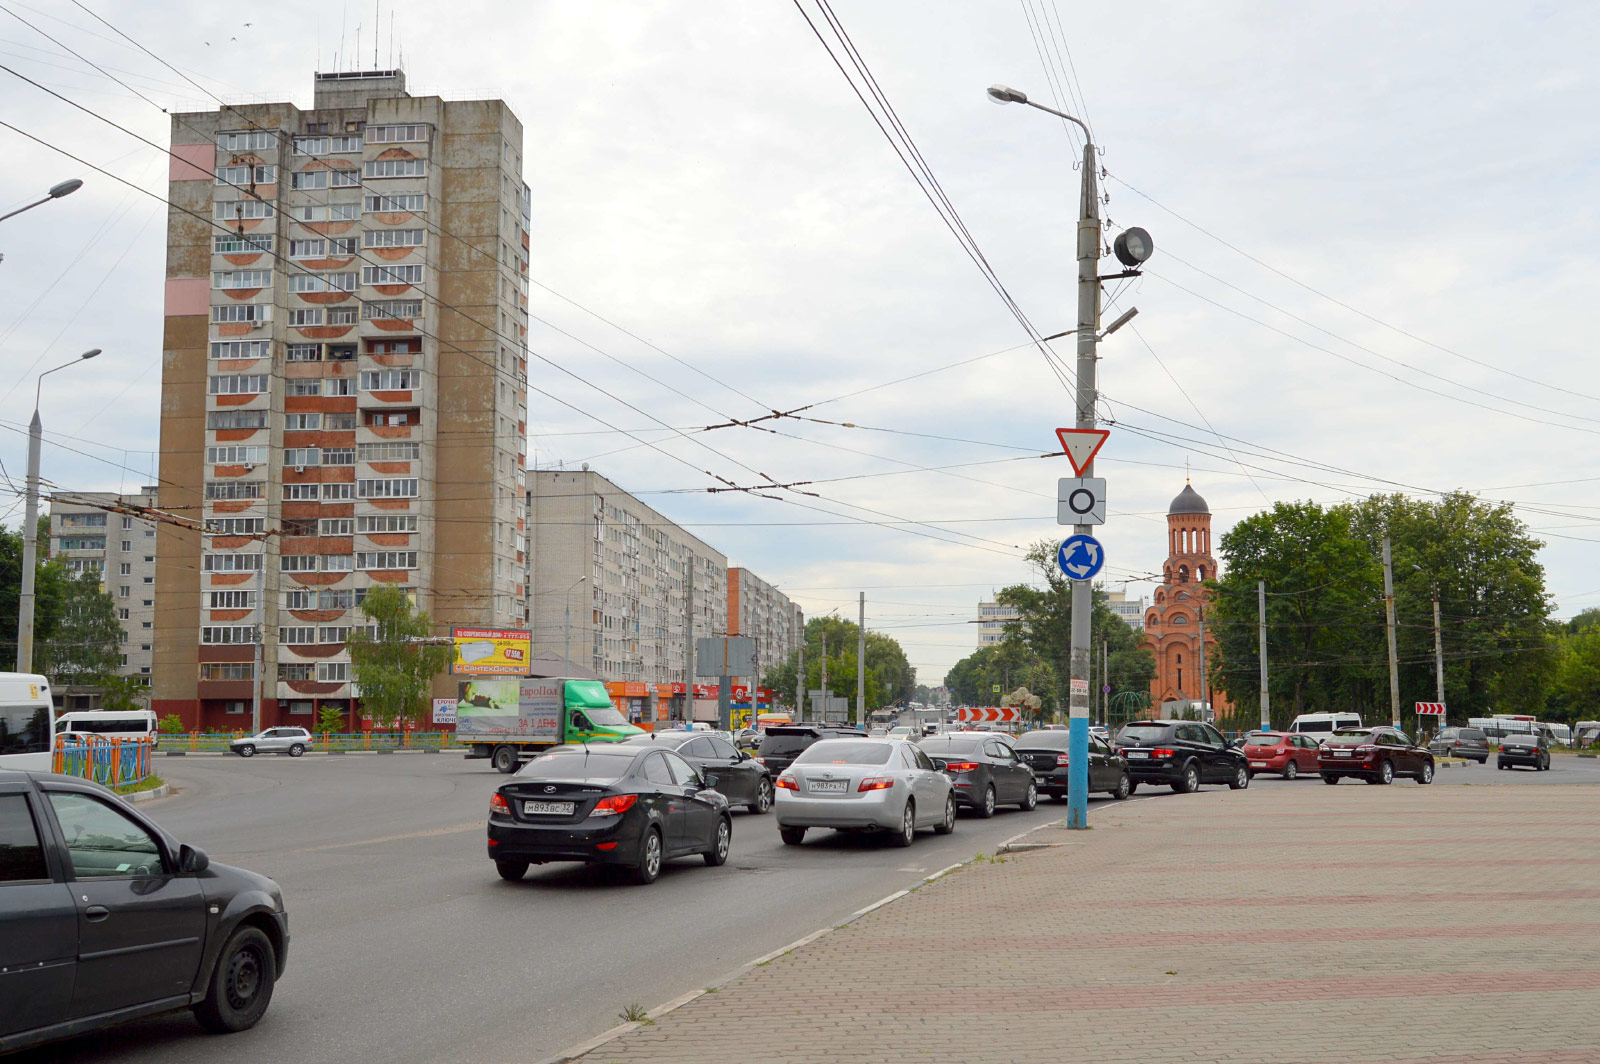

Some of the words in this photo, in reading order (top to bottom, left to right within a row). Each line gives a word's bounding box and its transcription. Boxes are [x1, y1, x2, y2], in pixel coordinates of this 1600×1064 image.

[519, 718, 528, 728] ЗА
[531, 718, 535, 728] 1
[537, 718, 556, 729] ДЕНЬ
[527, 803, 560, 813] М893ВС
[561, 803, 571, 811] 32
